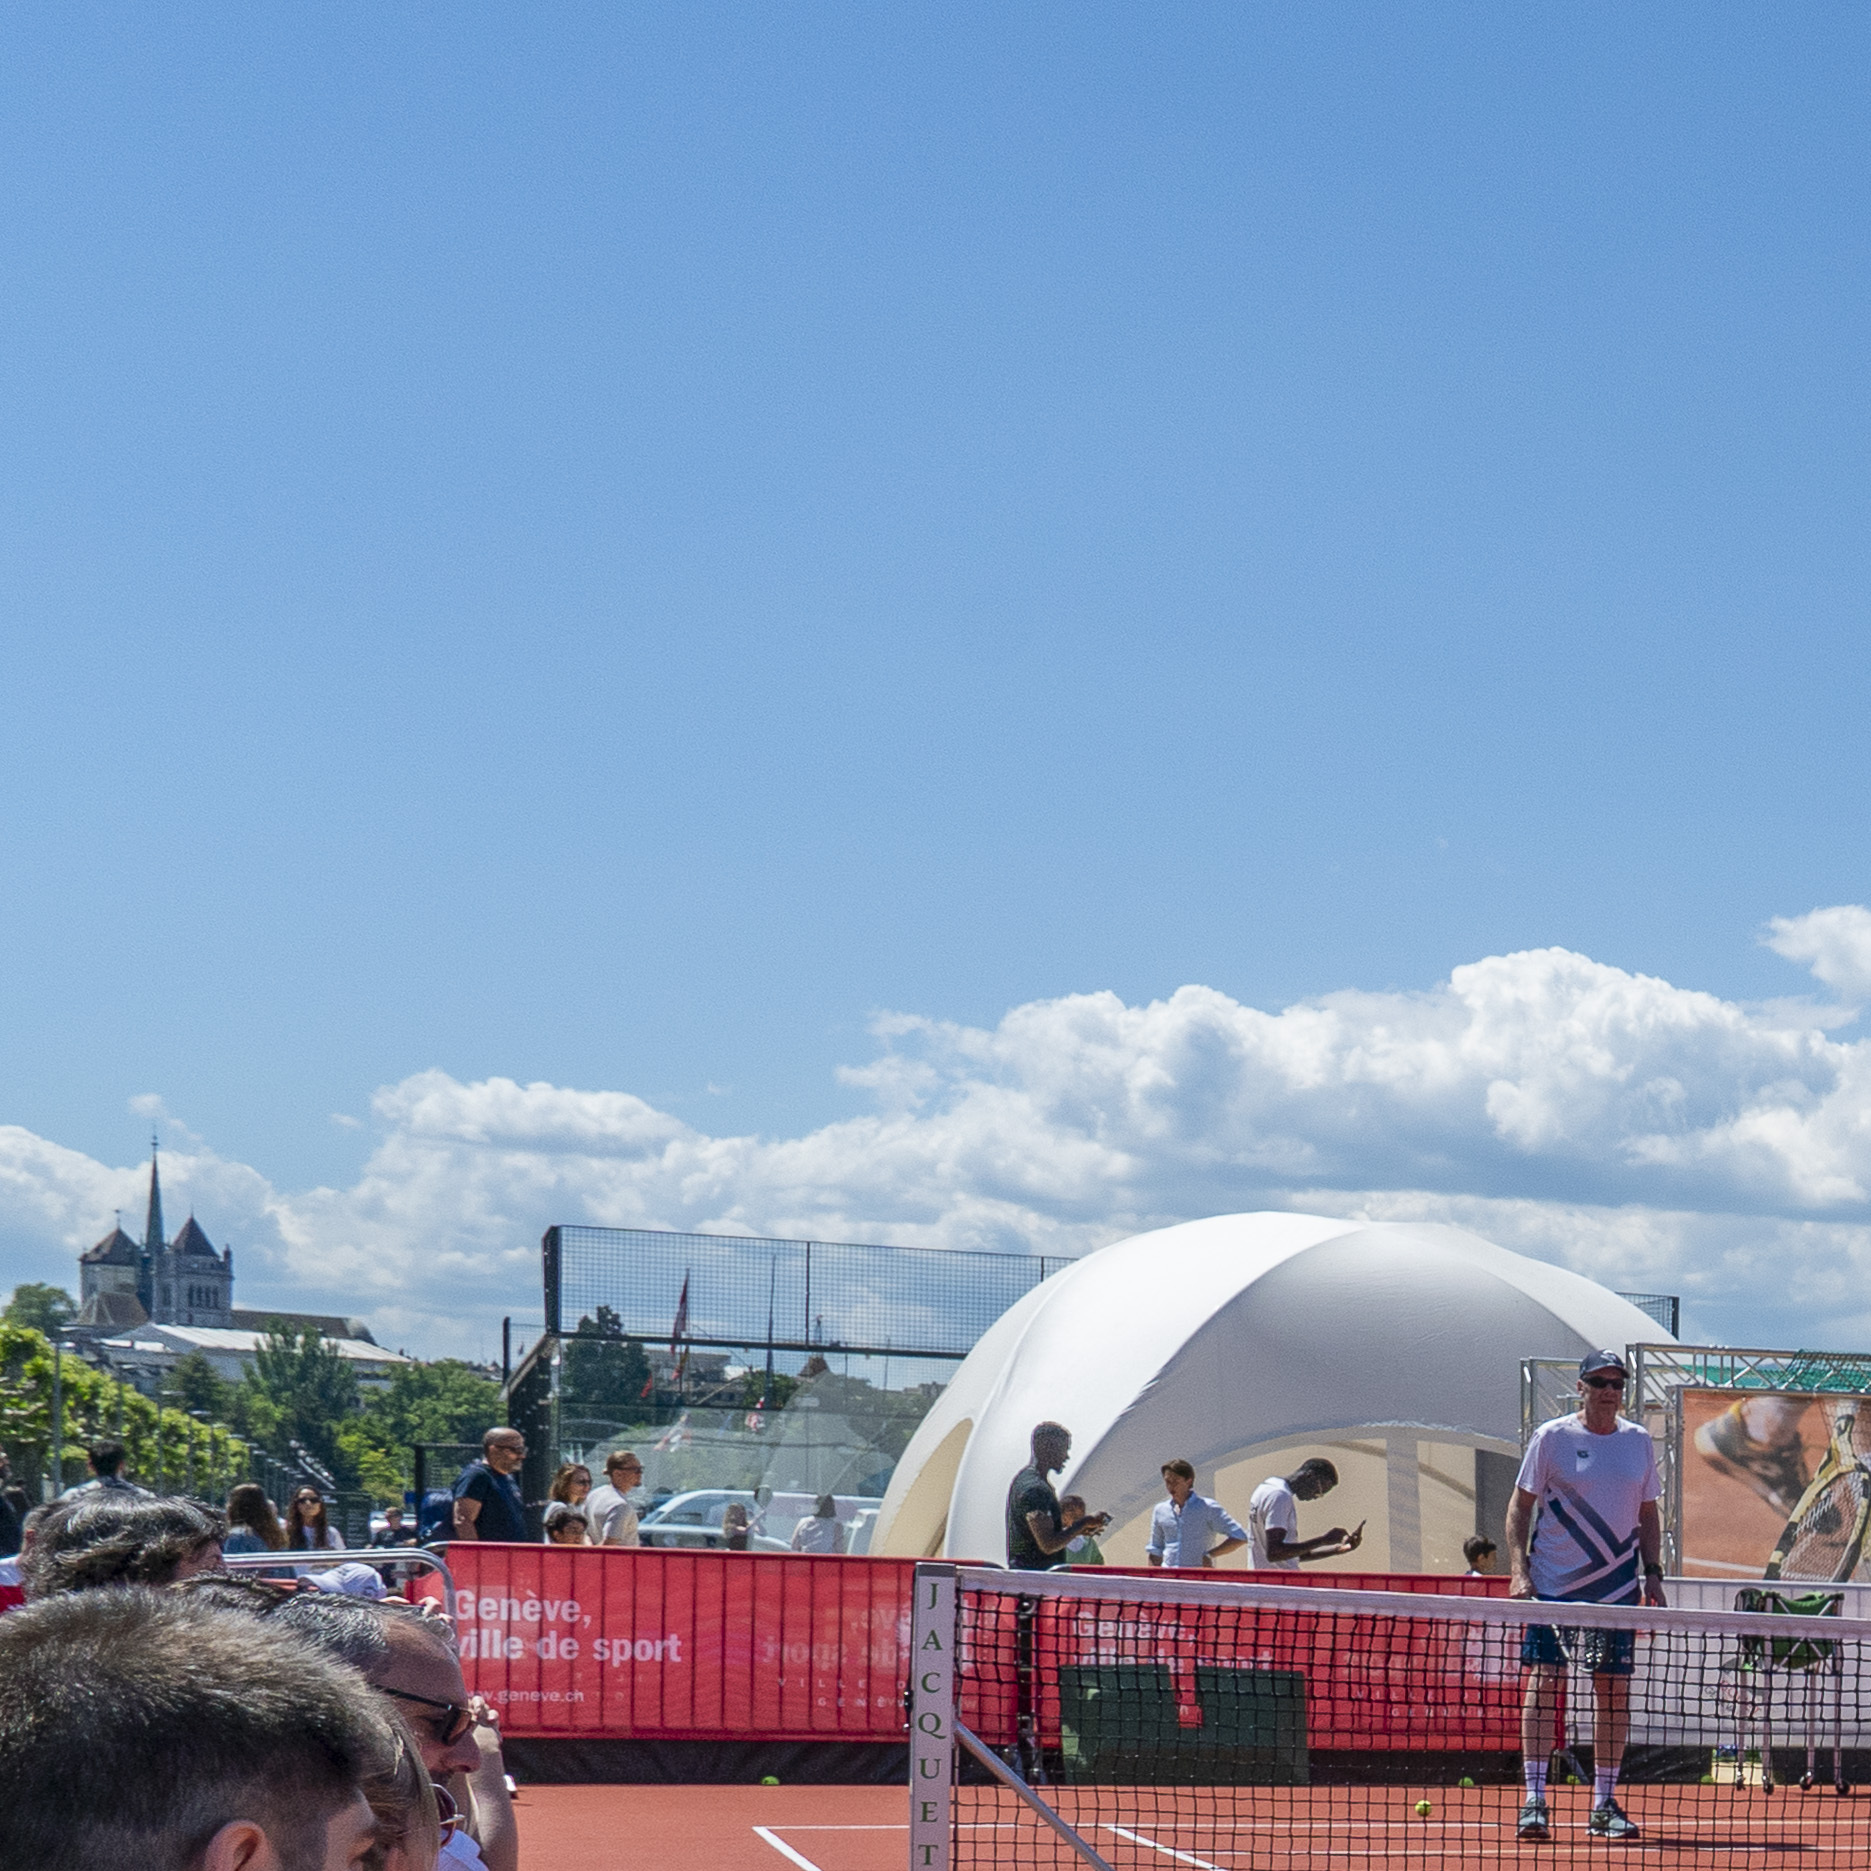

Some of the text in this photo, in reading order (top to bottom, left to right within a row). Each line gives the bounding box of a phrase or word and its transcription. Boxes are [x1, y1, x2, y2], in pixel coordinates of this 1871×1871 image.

[455, 1588, 592, 1629] Genève,
[536, 1630, 580, 1661] de
[592, 1632, 683, 1668] sport
[466, 1689, 585, 1705] ww.geneve.ch
[777, 1677, 867, 1690] VILLE
[917, 1582, 947, 1867] JACQUET
